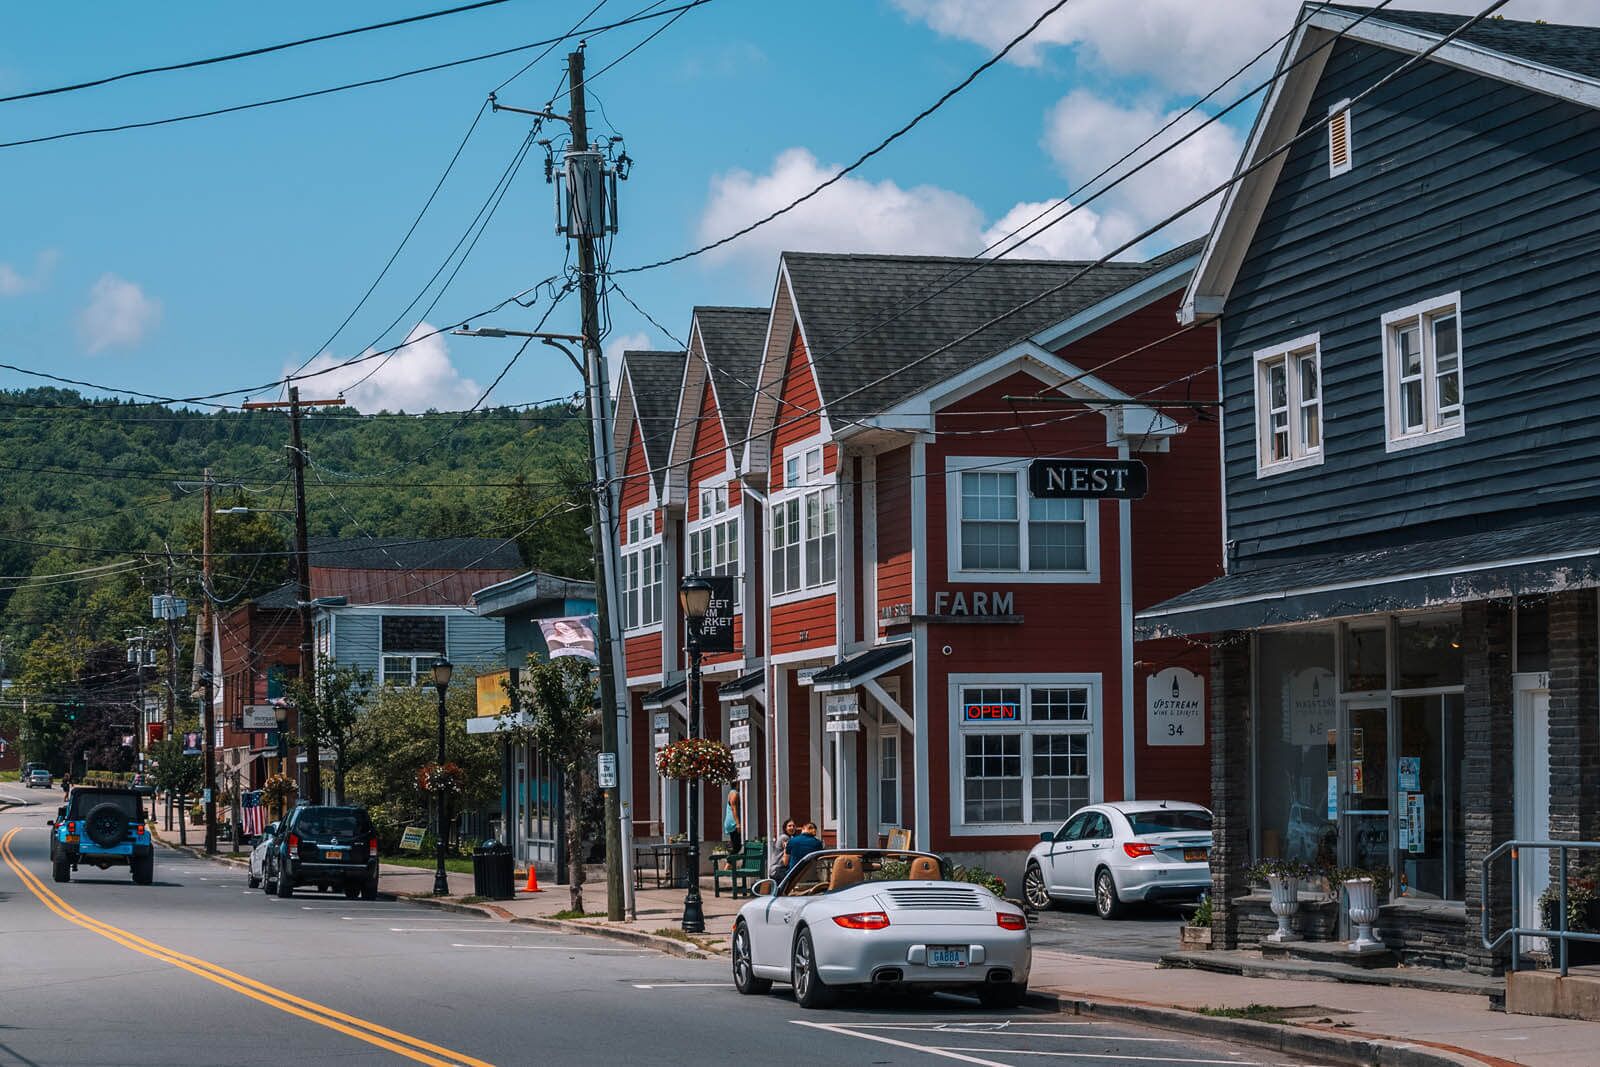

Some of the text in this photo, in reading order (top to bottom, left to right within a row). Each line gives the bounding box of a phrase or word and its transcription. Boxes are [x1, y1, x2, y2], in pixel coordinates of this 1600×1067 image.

[1046, 467, 1129, 491] NEST
[935, 591, 1014, 616] FARM
[702, 617, 733, 626] RKET
[1153, 699, 1199, 709] UPSTREAM
[968, 705, 1013, 718] OPEN
[1168, 723, 1184, 736] 34
